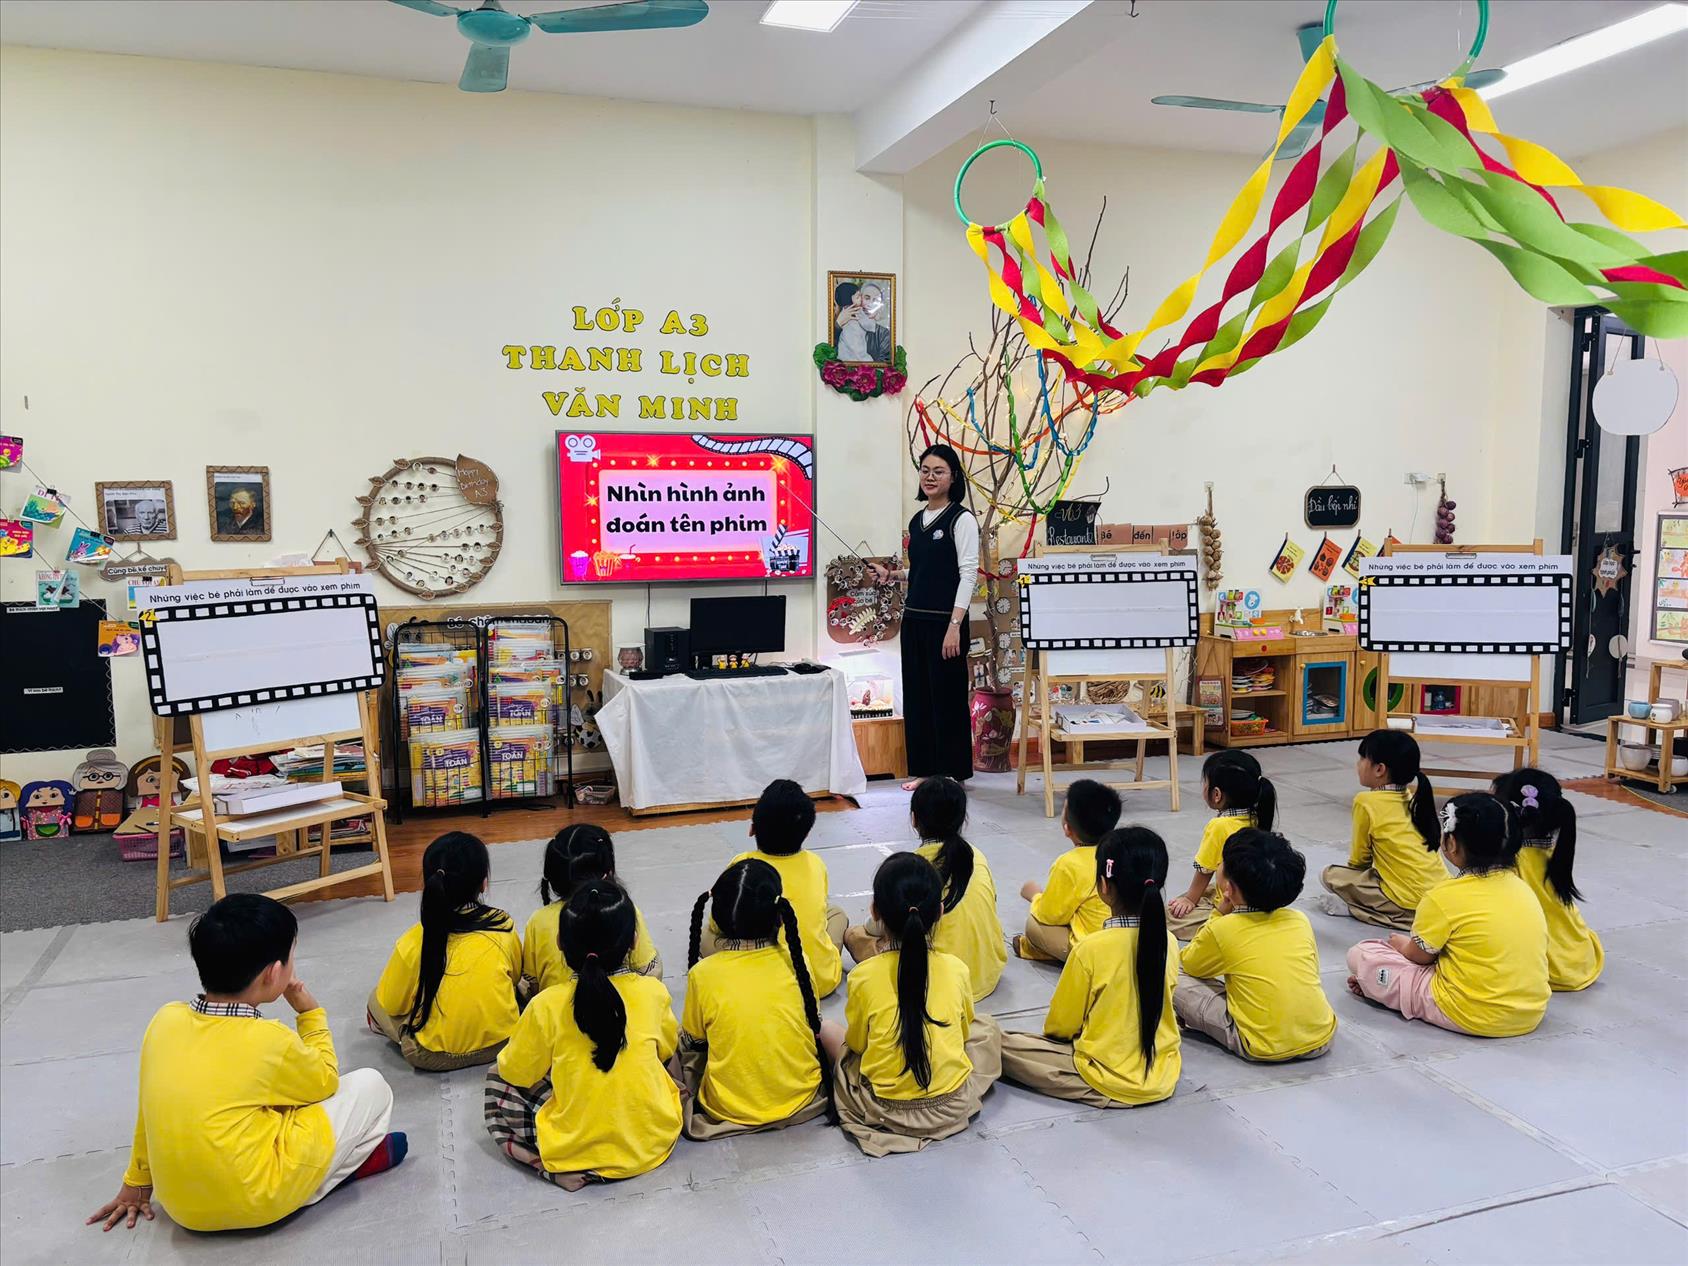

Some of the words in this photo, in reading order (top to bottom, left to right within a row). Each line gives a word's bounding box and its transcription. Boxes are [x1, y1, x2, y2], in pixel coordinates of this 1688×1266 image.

[571, 297, 644, 333] LỚP
[659, 309, 709, 337] A3
[502, 344, 643, 372] THANH
[659, 350, 750, 384] LỊCH
[542, 387, 621, 418] VĂN
[639, 396, 738, 421] MINH
[607, 482, 662, 502] Nhìn
[667, 482, 718, 502] hình
[723, 482, 765, 502] ảnh
[606, 513, 665, 533] đoán
[670, 514, 705, 533] tên
[710, 514, 767, 535] phim
[1133, 530, 1151, 540] đến
[108, 566, 126, 576] Cùng
[1170, 561, 1186, 569] phim
[1538, 563, 1558, 571] phim
[149, 593, 181, 603] Những
[185, 592, 205, 601] việc
[208, 591, 221, 599] bé
[224, 589, 243, 600] phải
[246, 588, 263, 597] làm
[264, 585, 276, 595] để
[278, 585, 299, 595] được
[302, 584, 318, 592] vào
[341, 582, 361, 591] phim
